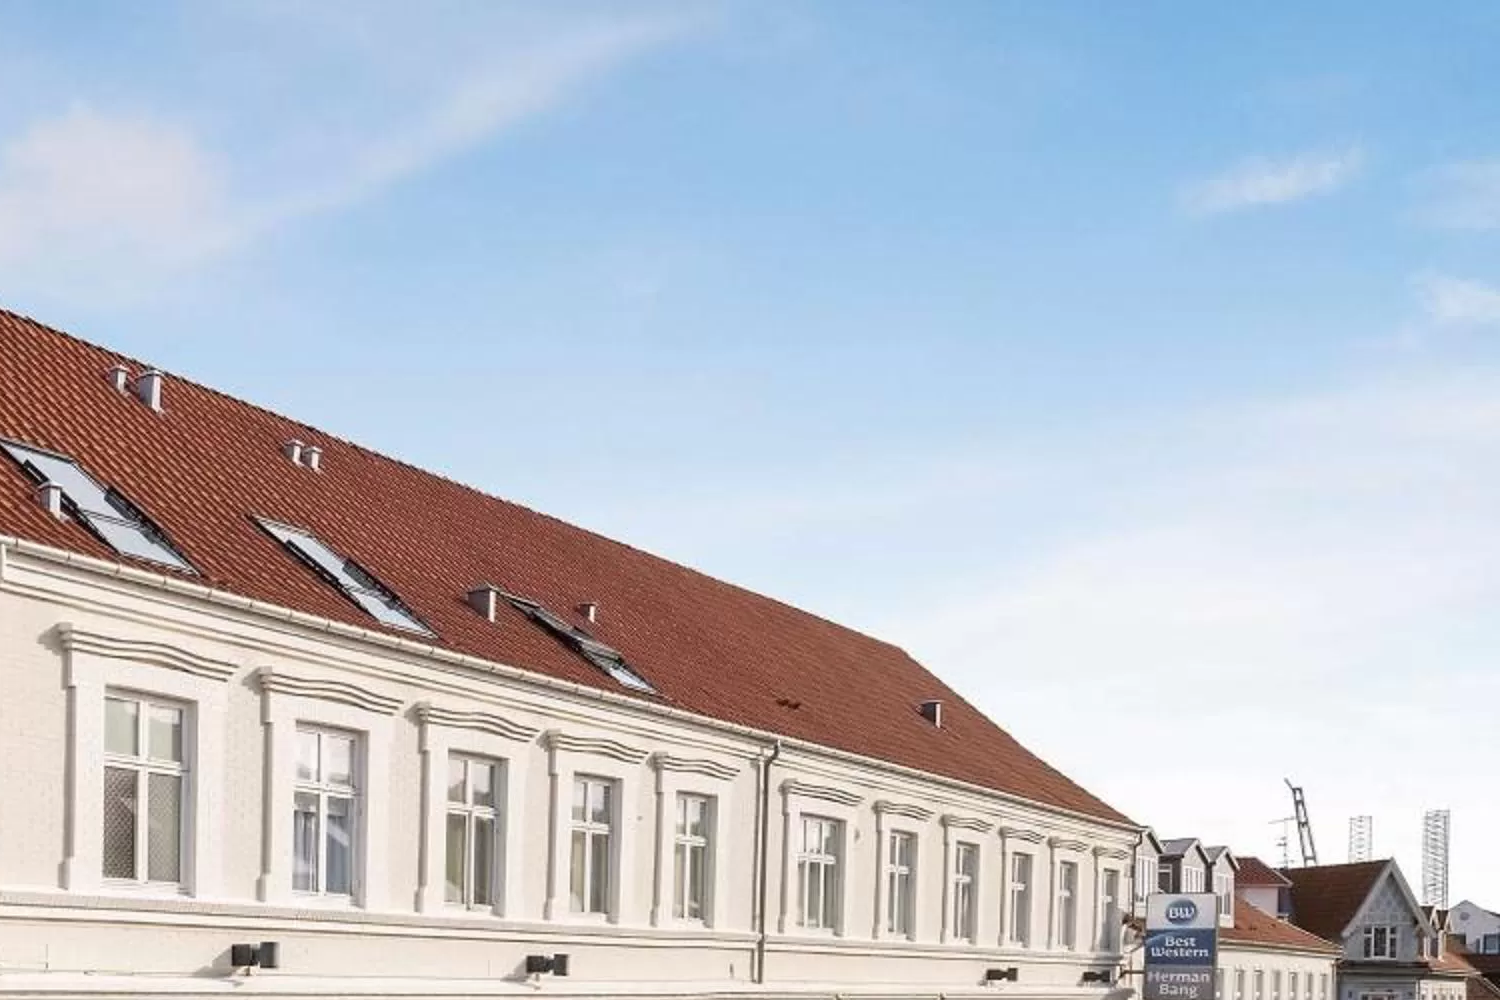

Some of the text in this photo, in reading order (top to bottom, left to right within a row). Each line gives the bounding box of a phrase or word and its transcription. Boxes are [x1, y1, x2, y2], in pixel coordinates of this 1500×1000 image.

[1168, 906, 1195, 919] BW
[1164, 935, 1197, 947] Best
[1151, 946, 1209, 958] Western
[1147, 971, 1210, 983] Herman
[1159, 983, 1199, 999] Bang
